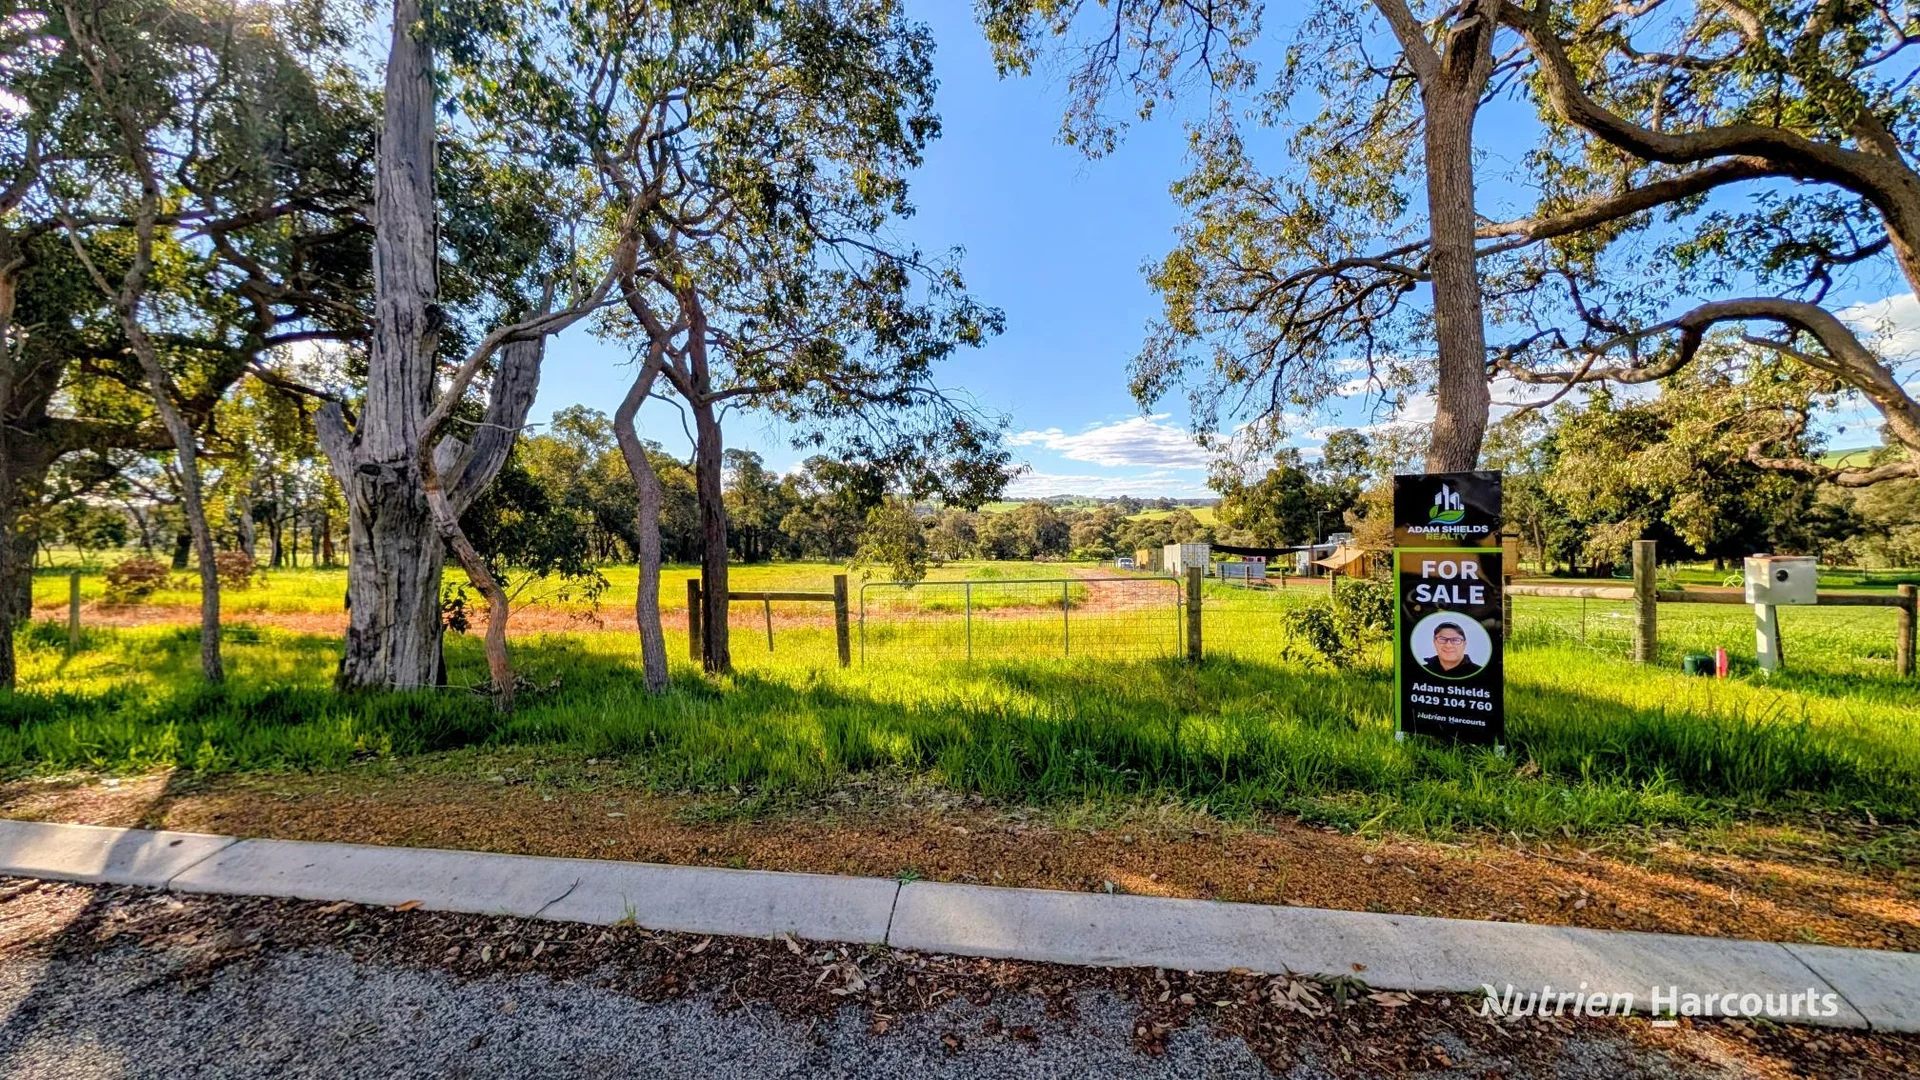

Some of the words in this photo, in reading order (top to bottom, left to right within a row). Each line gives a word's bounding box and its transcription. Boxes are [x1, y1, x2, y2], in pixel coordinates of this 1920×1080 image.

[1407, 525, 1440, 534] ADAM
[1441, 525, 1489, 534] SHIELDS
[1425, 533, 1468, 541] REALTY
[1422, 560, 1479, 580] FOR
[1415, 583, 1485, 605] SALE
[1412, 682, 1445, 694] Adam
[1447, 686, 1491, 699] Shields
[1410, 694, 1440, 705] 0429
[1443, 697, 1466, 709] 104
[1469, 700, 1493, 712] 760
[1417, 711, 1446, 722] Nutrien
[1448, 716, 1486, 727] Harcourts
